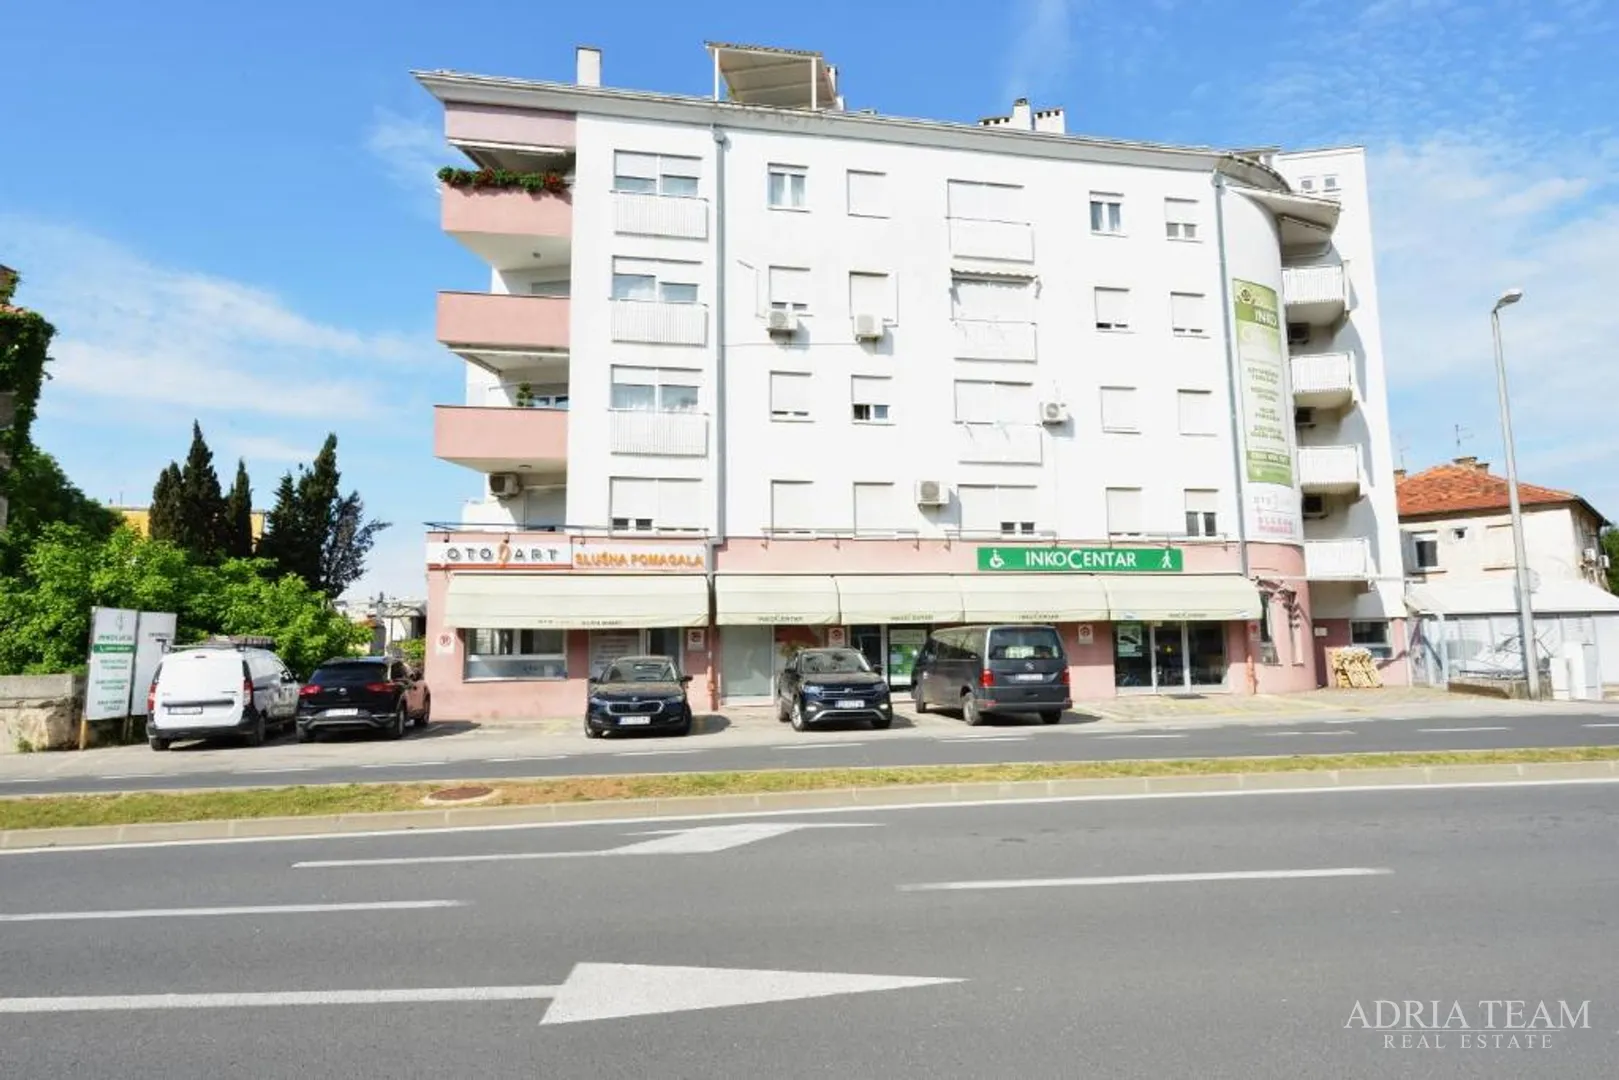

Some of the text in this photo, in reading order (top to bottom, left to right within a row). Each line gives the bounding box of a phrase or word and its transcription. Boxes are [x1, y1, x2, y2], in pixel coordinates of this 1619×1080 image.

[446, 547, 559, 561] OTO ART
[1025, 549, 1137, 569] INKOCENTAR
